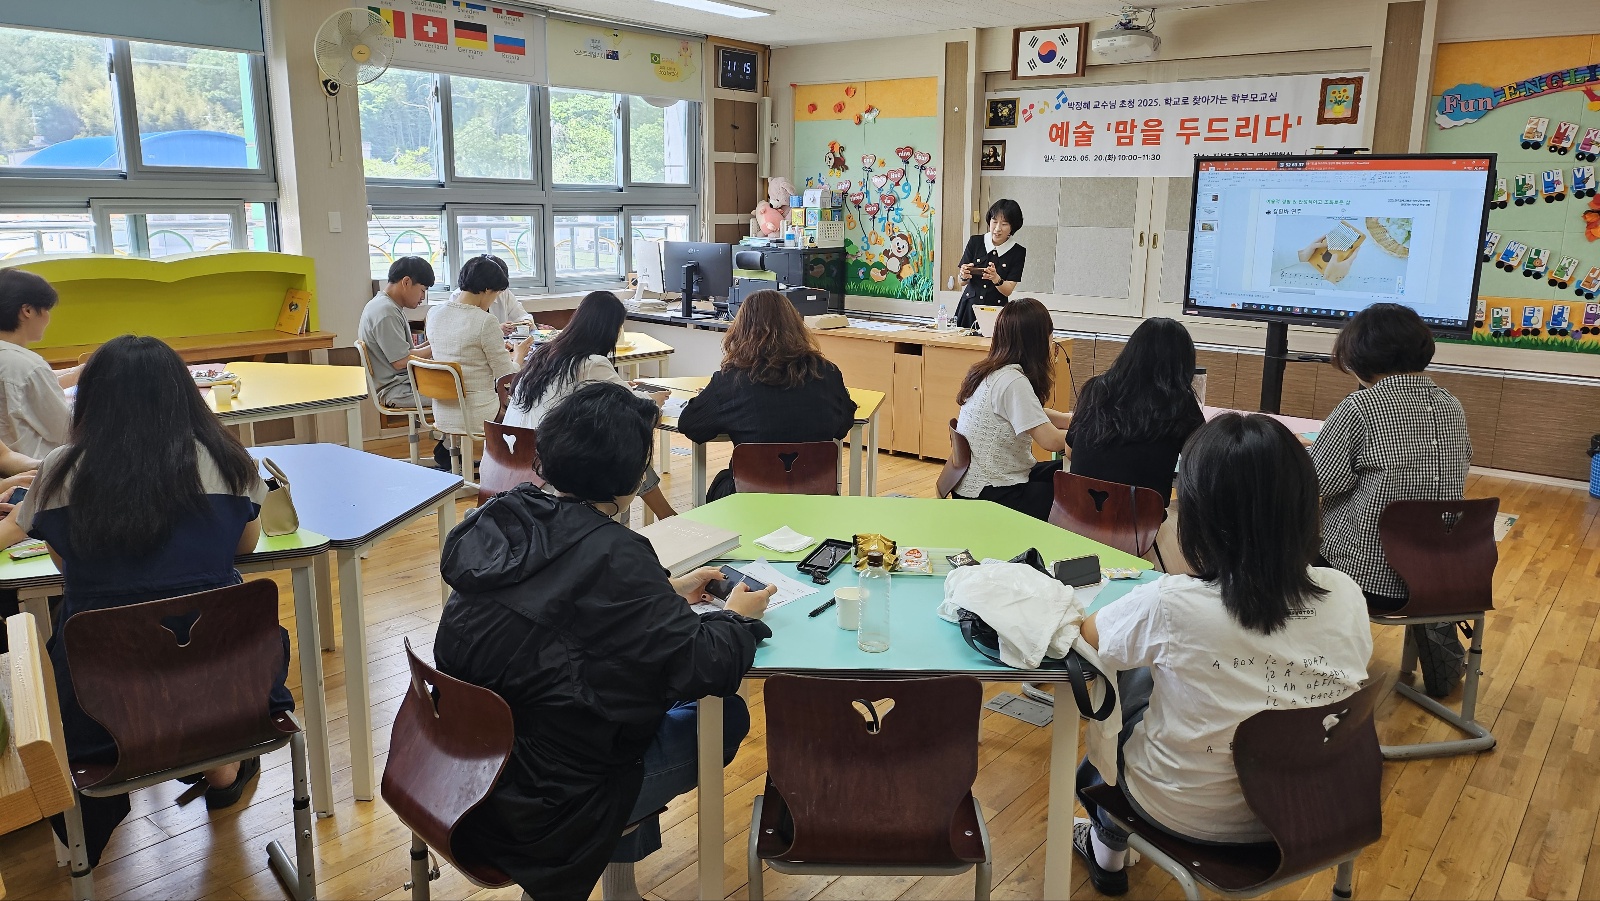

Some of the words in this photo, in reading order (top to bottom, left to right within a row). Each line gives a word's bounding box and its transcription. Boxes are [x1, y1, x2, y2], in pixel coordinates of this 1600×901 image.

[457, 6, 480, 15] Sweden
[496, 14, 521, 22] Denmark
[457, 46, 484, 57] Germany
[1093, 100, 1117, 110] 교수님
[1119, 99, 1135, 108] 초청
[1137, 98, 1161, 108] 2025.
[1164, 96, 1190, 106] 학교로
[1192, 94, 1228, 106] 찾아가는
[1231, 92, 1278, 103] 학부모교실
[1442, 94, 1494, 114] Fun
[1560, 122, 1571, 133] Y
[1048, 120, 1095, 148] 예술
[1587, 129, 1599, 140] X
[1060, 154, 1079, 162] 2025.
[1080, 154, 1091, 162] 05.
[1543, 171, 1554, 181] U
[1573, 168, 1584, 178] V
[1515, 175, 1526, 186] T
[902, 182, 912, 200] 9
[892, 207, 904, 224] 5
[878, 216, 887, 232] 7
[861, 236, 871, 251] 3
[868, 230, 878, 246] 0
[1493, 308, 1502, 318] D
[1526, 307, 1535, 316] E
[1554, 306, 1564, 315] F
[1212, 660, 1220, 670] A
[1233, 656, 1255, 668] BOX
[1206, 745, 1213, 754] A
